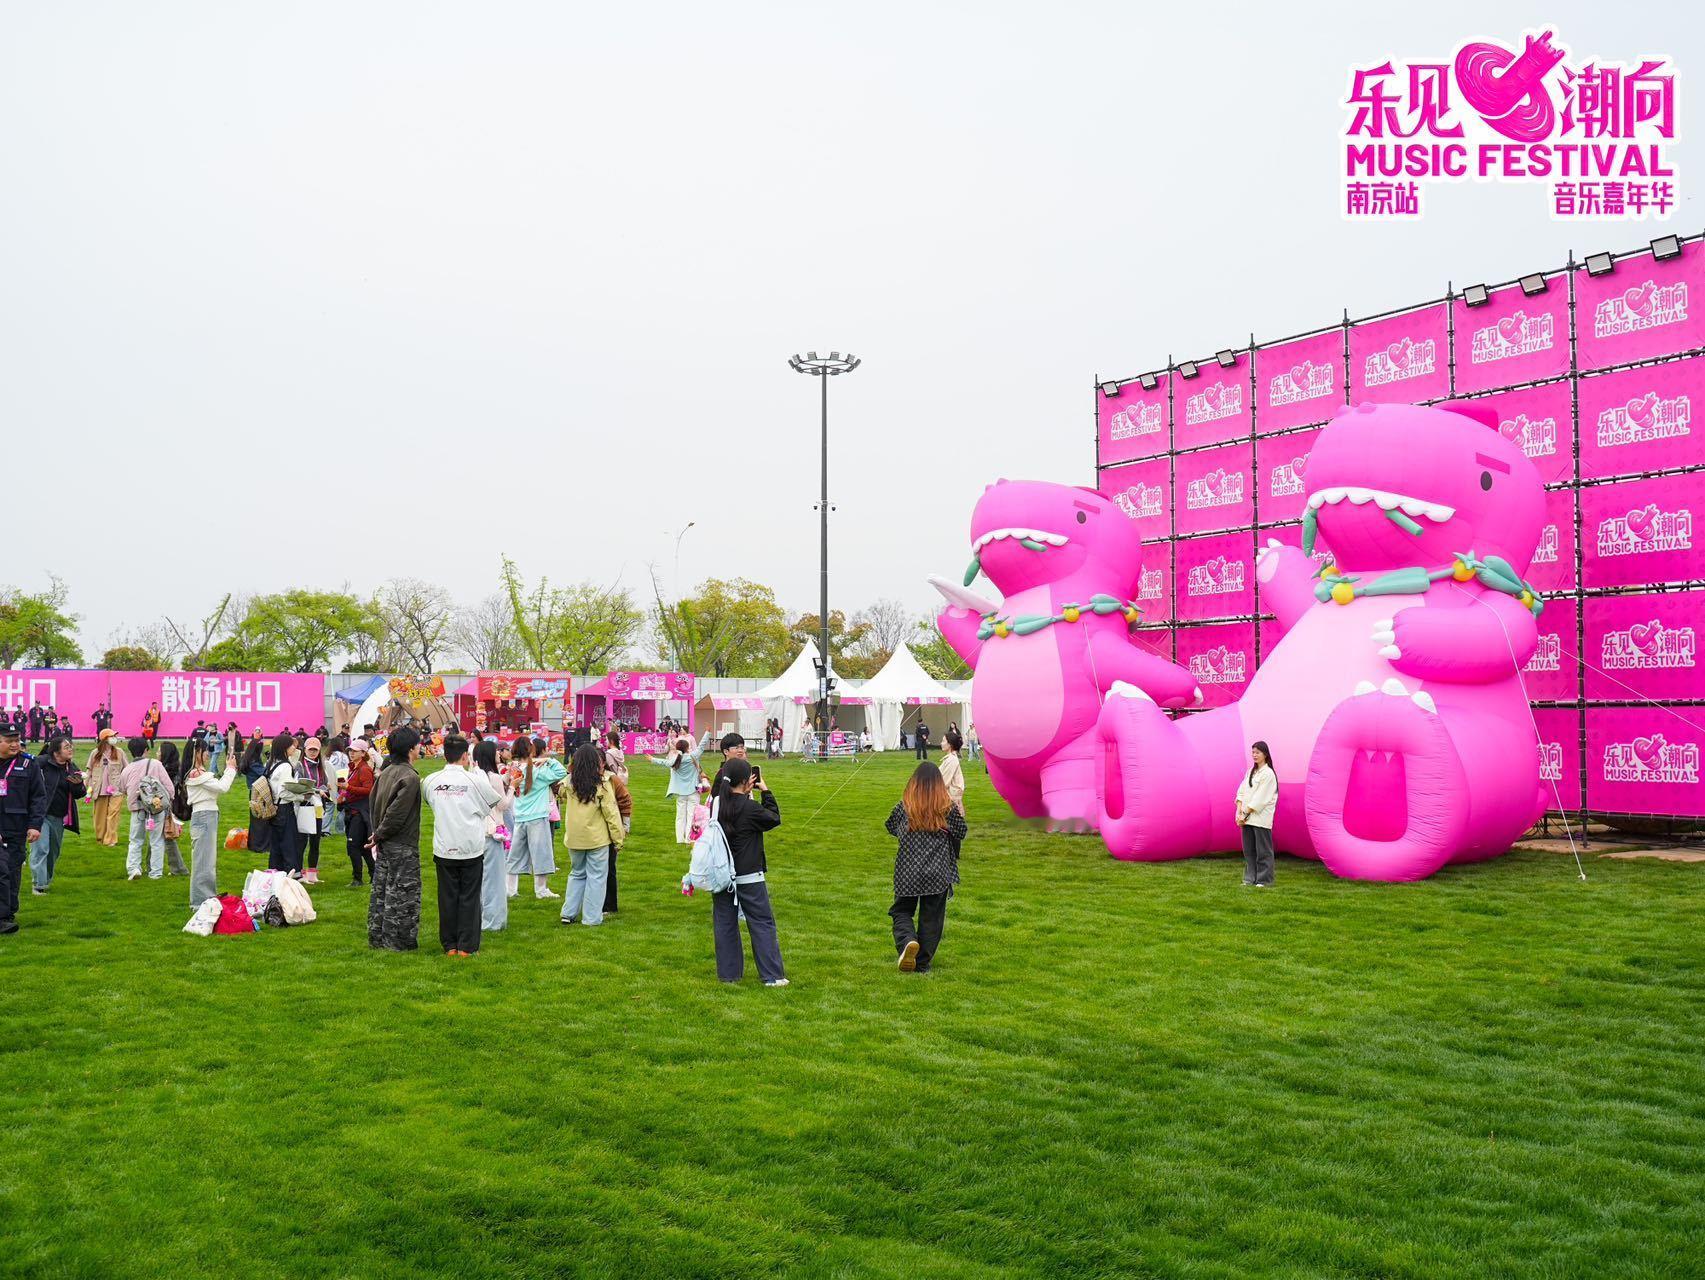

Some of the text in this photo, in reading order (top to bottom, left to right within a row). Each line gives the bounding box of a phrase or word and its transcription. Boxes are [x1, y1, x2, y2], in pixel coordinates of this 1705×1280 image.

[1597, 310, 1687, 336] MUSIC FESTIVAL
[1474, 339, 1552, 362] MUSIC FESTIVAL
[1367, 364, 1434, 385] MUSIC FESTIVAL
[1271, 385, 1332, 405] MUSIC FESTIVAL
[1187, 406, 1241, 424] MUSIC FESTIVAL
[1600, 423, 1689, 445] MUSIC FESTIVAL
[1525, 443, 1554, 455] TIVAL
[1273, 484, 1295, 495] MUSIC
[1188, 494, 1242, 508] MUSIC FESTIVAL
[1600, 537, 1690, 555] MUSIC FESTIVAL
[1189, 582, 1243, 594] MUSIC FESTIVAL
[1604, 655, 1694, 667] MUSIC FESTIVAL
[1212, 672, 1245, 681] FESTIVAL
[0, 675, 56, 711] 出口
[162, 676, 280, 712] 散场出口
[1605, 769, 1697, 781] MUSIC FESTIVAL
